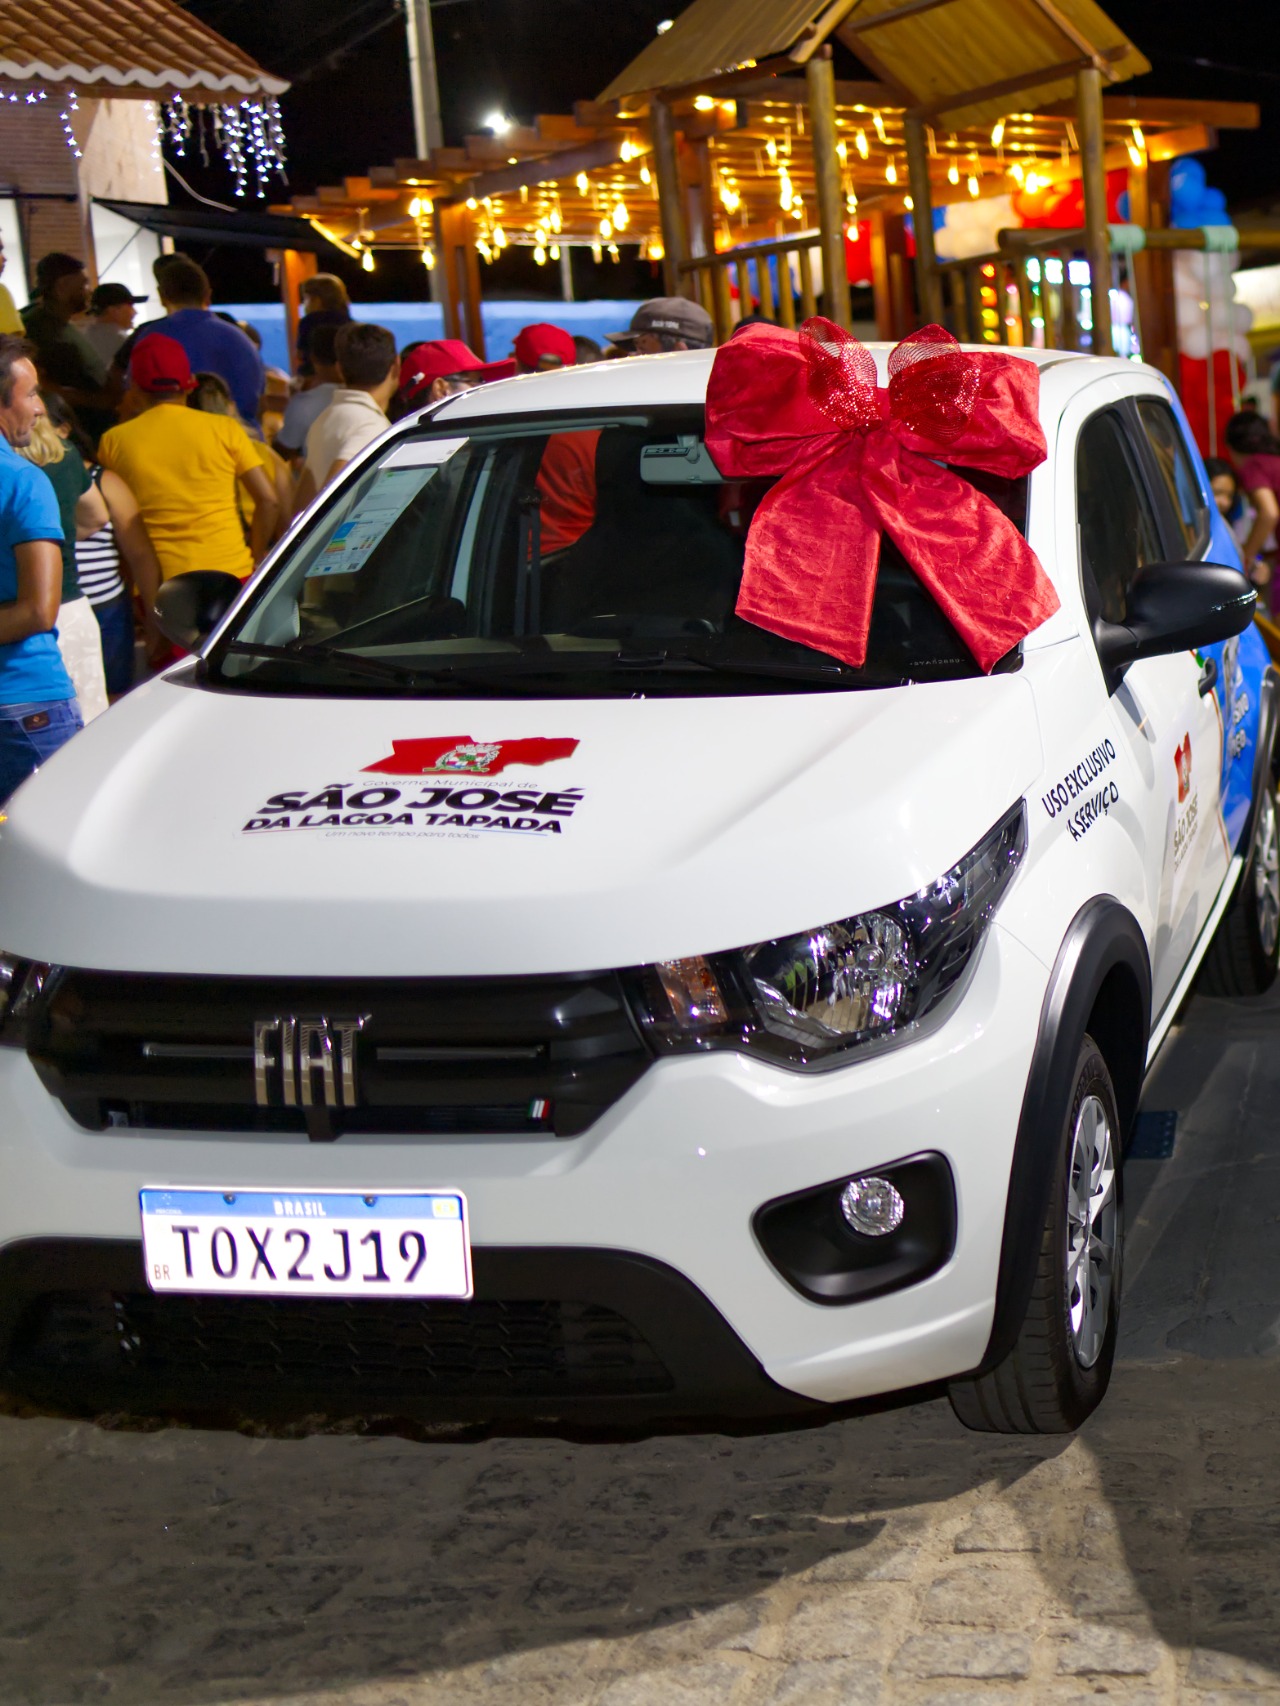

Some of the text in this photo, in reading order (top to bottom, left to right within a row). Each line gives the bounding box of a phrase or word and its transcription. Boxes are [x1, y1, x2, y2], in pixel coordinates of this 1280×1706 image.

[362, 778, 538, 789] Governo Municipal de
[1041, 738, 1116, 818] USO EXCLUSIVO
[256, 782, 587, 817] SÃO JOSÉ
[1074, 781, 1119, 834] SERVIÇO
[241, 812, 563, 834] DA LAGOA TAPADA
[254, 1016, 365, 1106] FIAT
[273, 1199, 327, 1218] BRASIL
[171, 1224, 428, 1283] TOX2J19
[153, 1263, 171, 1281] BR
